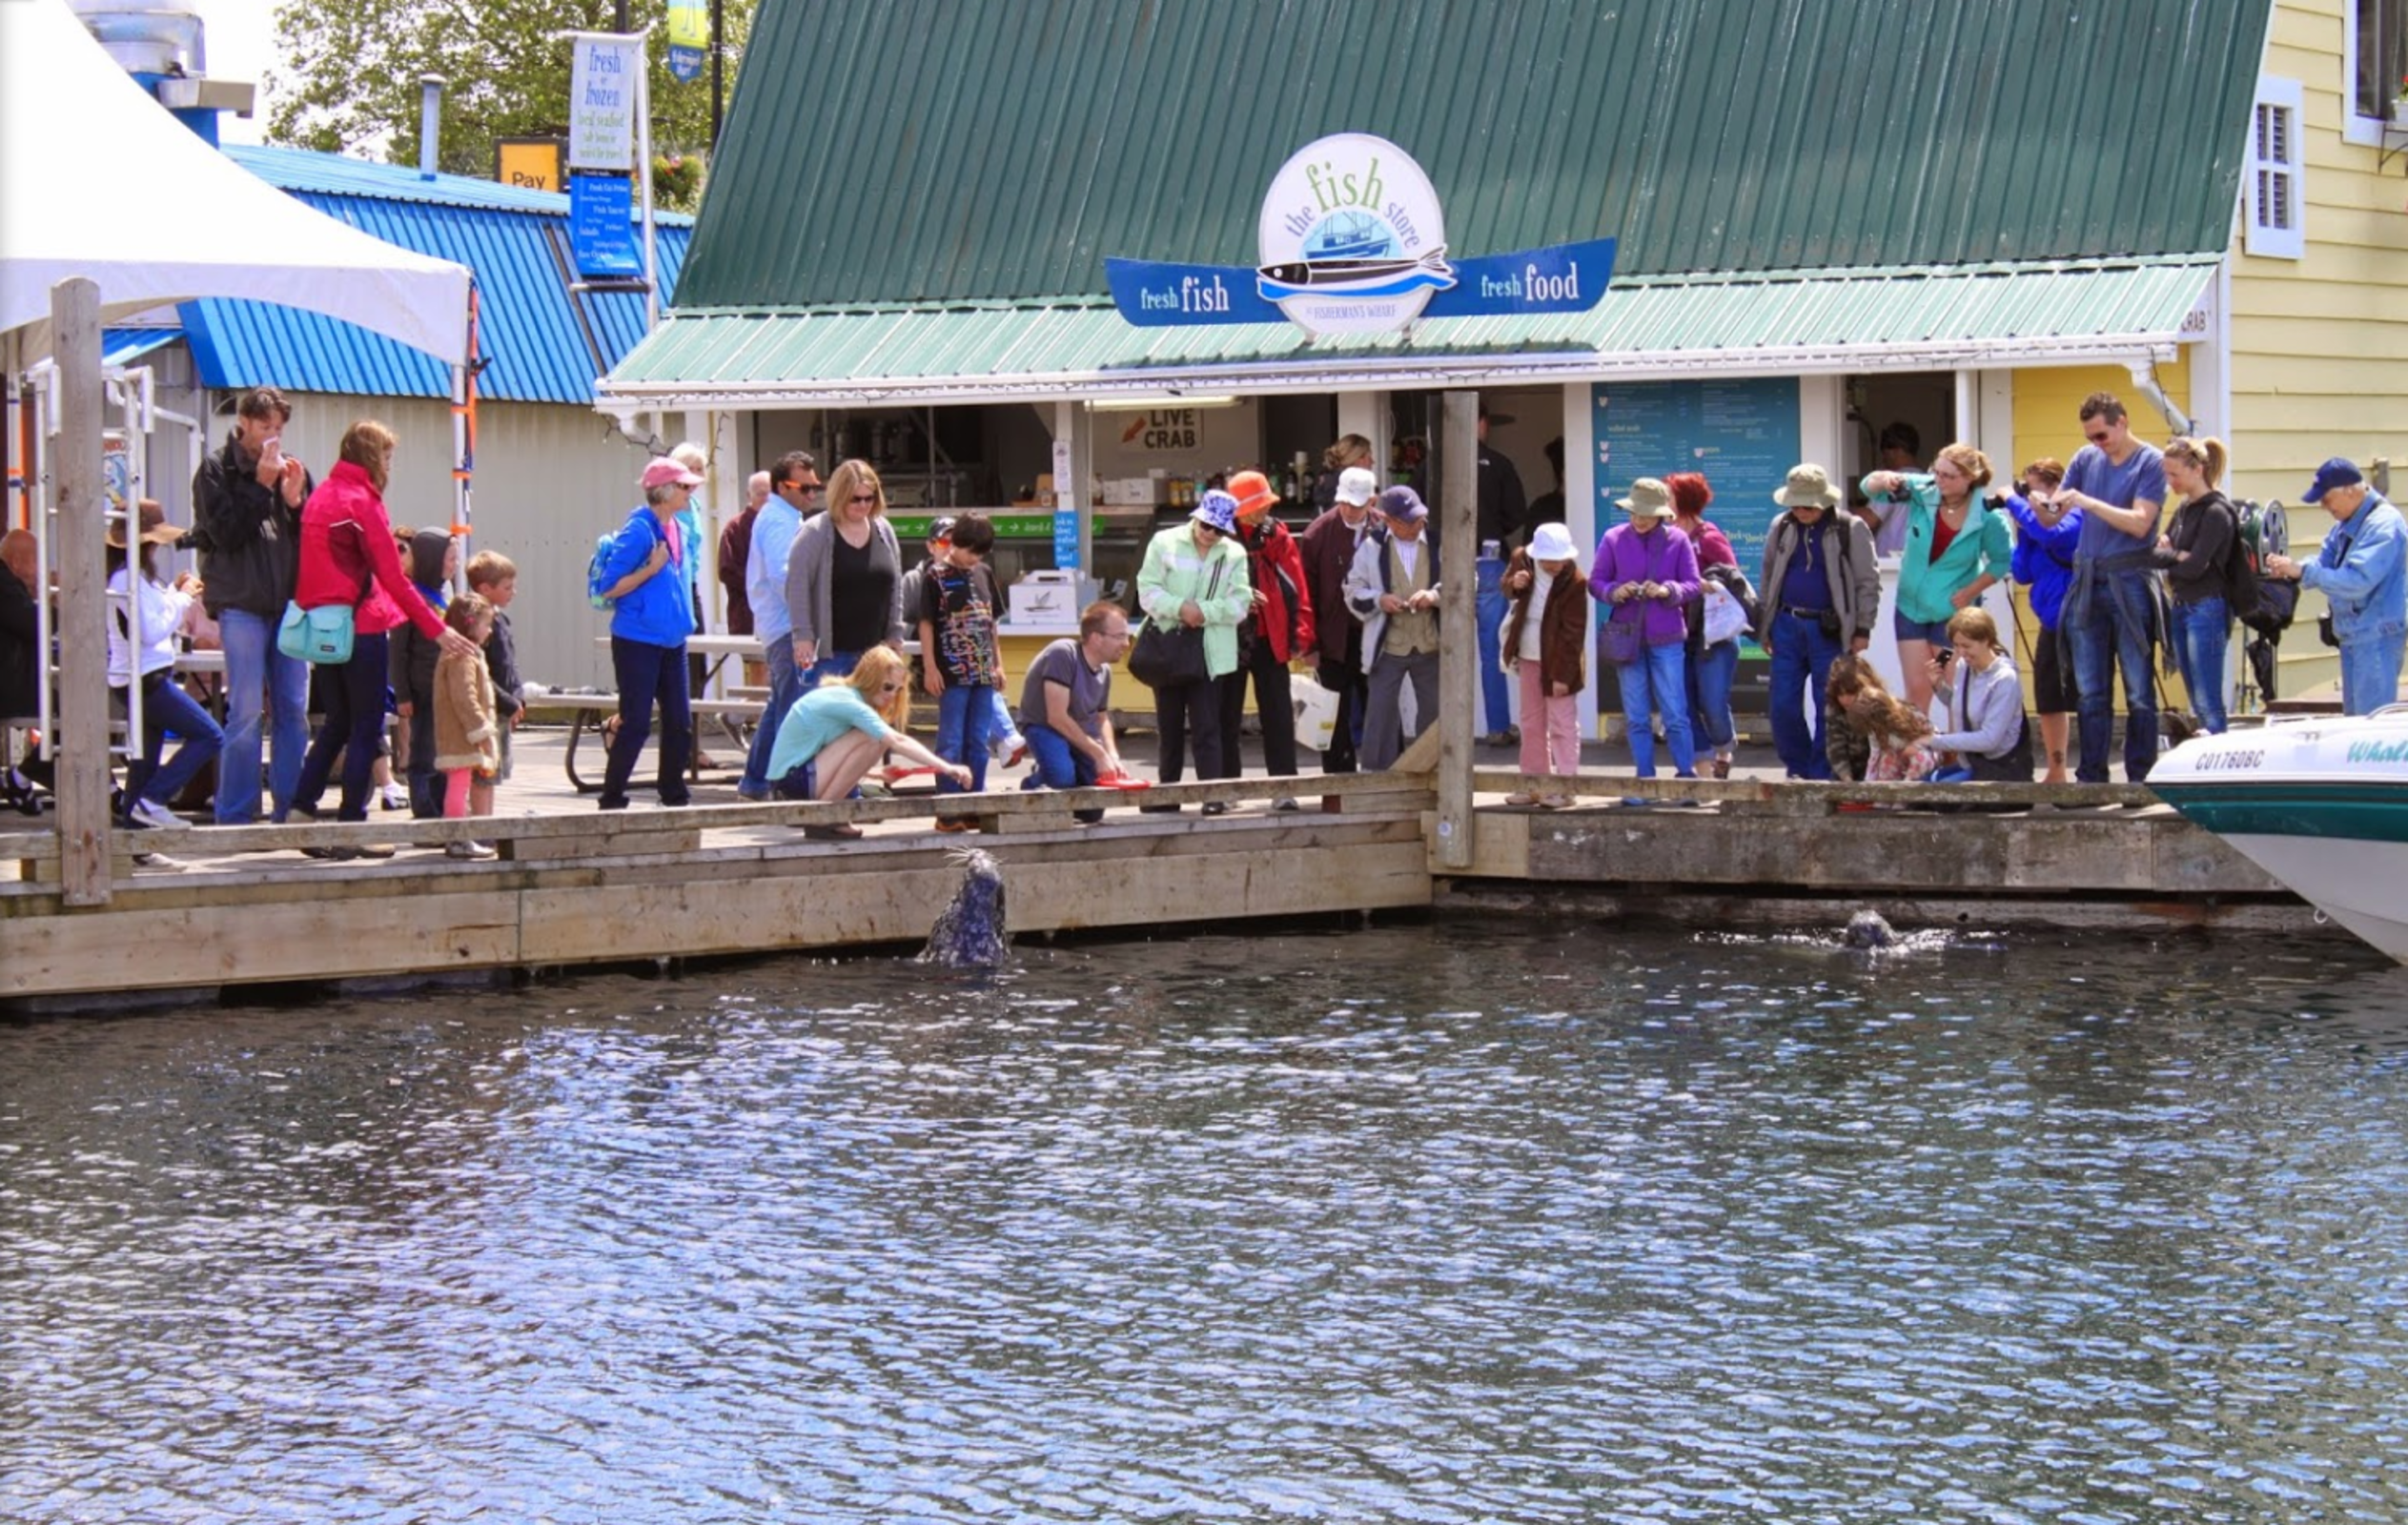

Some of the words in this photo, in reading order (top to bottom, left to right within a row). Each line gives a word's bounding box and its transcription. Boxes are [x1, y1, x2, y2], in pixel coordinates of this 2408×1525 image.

[589, 44, 621, 73] fresh
[584, 79, 621, 107] frozen
[512, 171, 546, 191] Pay
[1284, 206, 1316, 238] the
[1306, 157, 1382, 214] fish
[1382, 201, 1420, 250] store
[1141, 286, 1179, 310] fresh
[1181, 274, 1230, 313] fish
[1481, 273, 1522, 297] fresh
[1525, 261, 1580, 301] food
[1150, 408, 1194, 427] LIVE
[1144, 429, 1195, 449] CRAB
